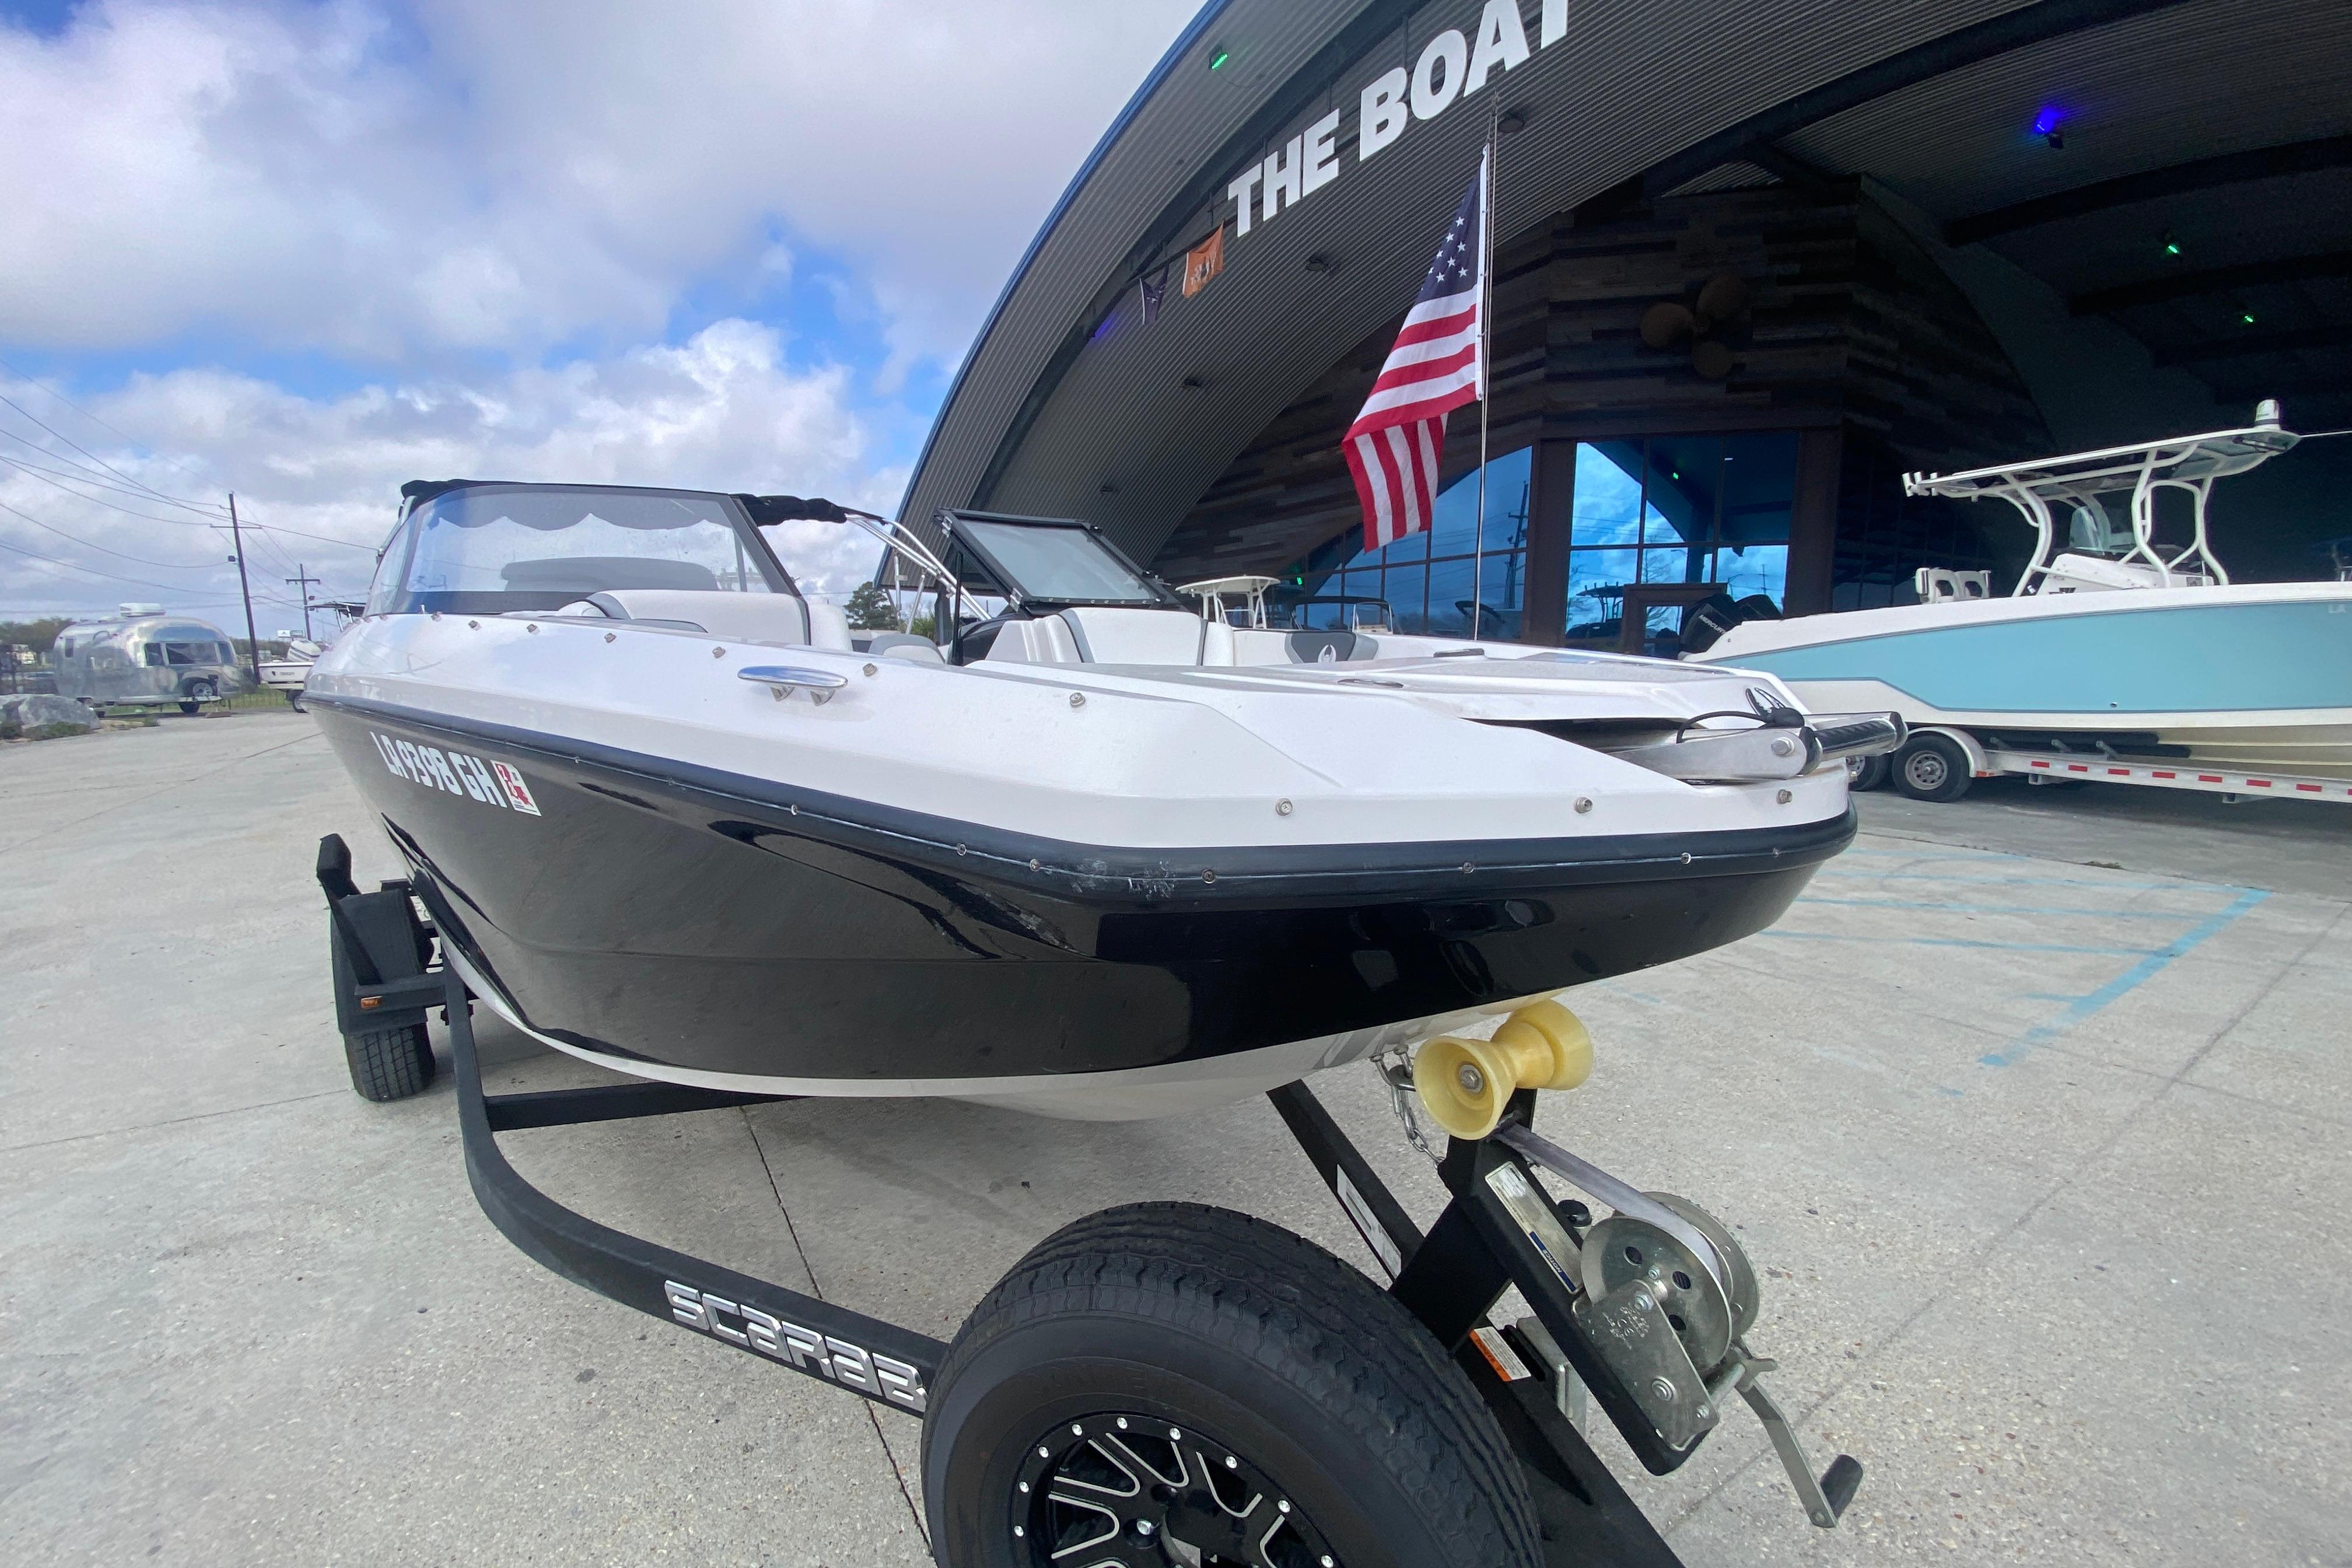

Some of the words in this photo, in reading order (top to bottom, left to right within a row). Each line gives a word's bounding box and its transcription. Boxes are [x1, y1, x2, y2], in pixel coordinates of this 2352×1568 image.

[1228, 108, 1339, 237] THE
[448, 751, 508, 808] GH
[1542, 1249, 1563, 1273] NOTICE
